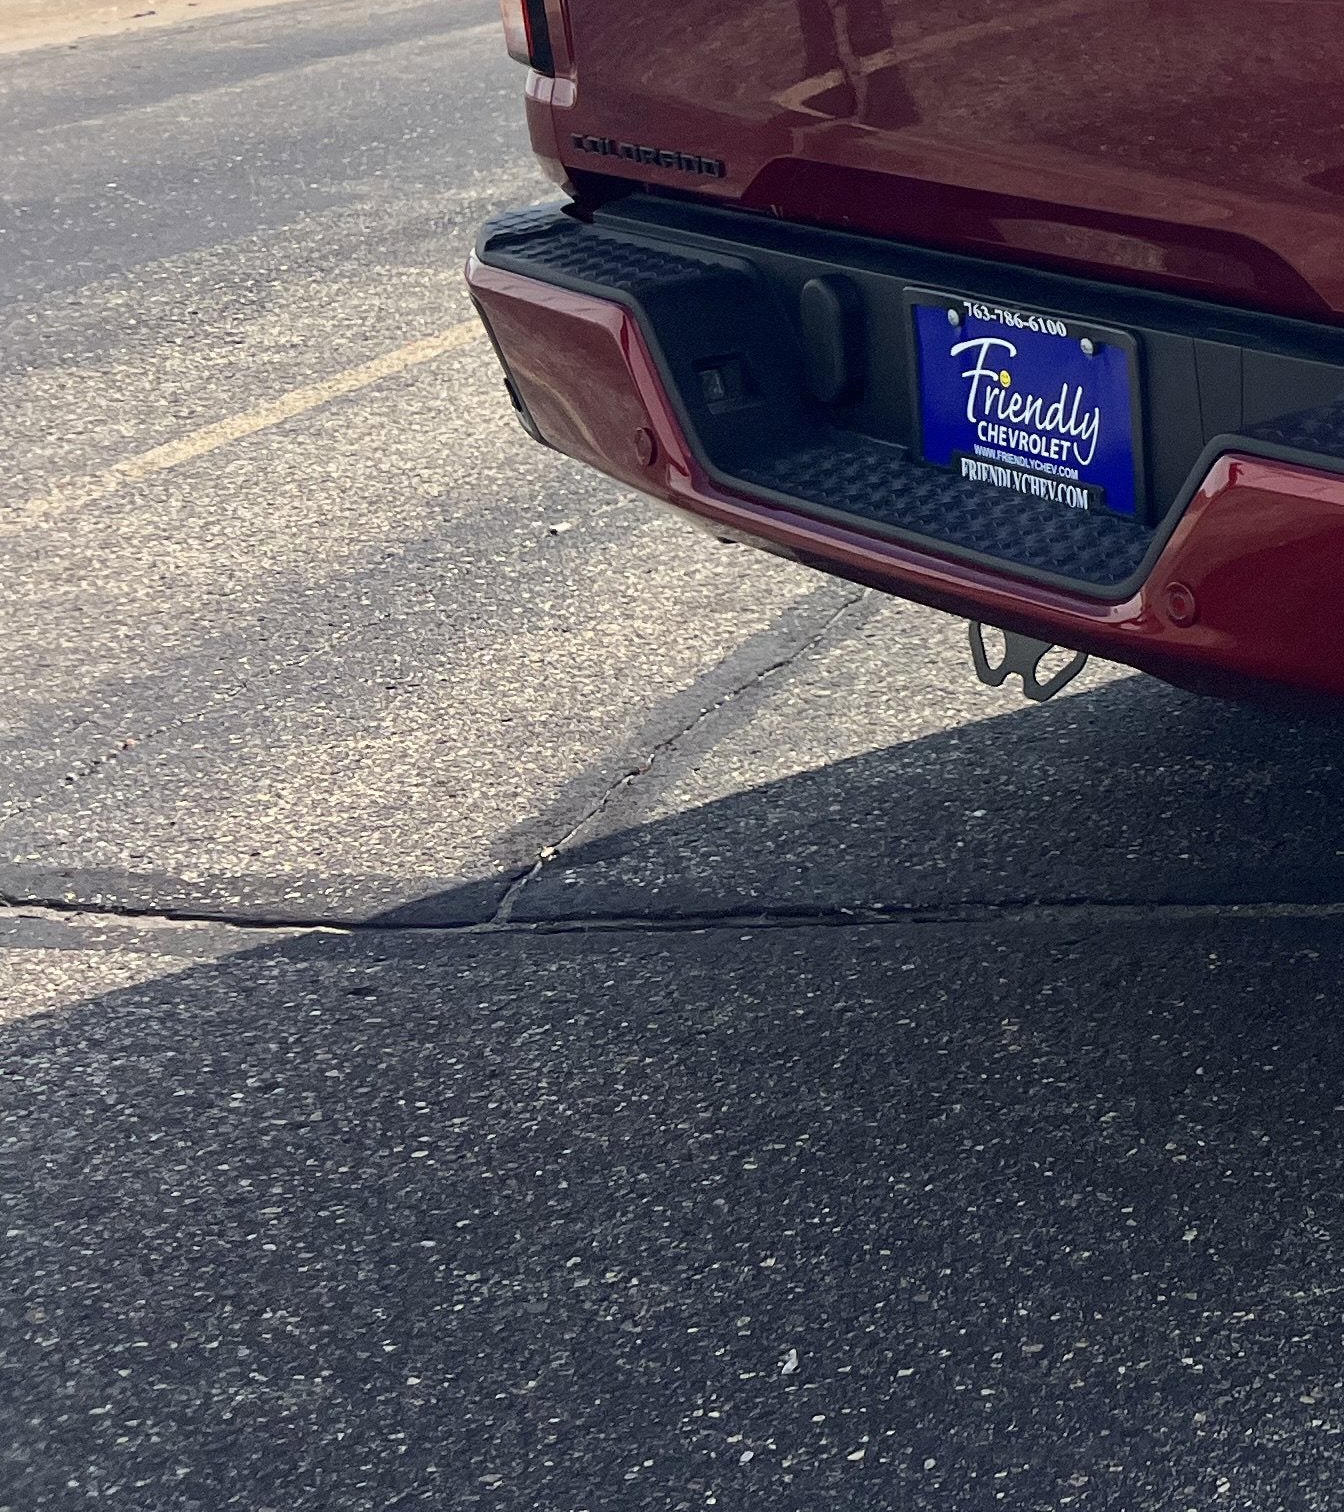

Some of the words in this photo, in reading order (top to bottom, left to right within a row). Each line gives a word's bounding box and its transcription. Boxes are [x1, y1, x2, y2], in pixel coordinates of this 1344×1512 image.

[570, 132, 726, 179] COLORADO
[963, 300, 1068, 338] 763-786-6100
[950, 336, 1100, 466] Friendly
[973, 443, 1080, 481] WWW.FRIENDLYCHEV.COM
[976, 420, 1072, 462] CHEVROLET
[960, 457, 1090, 511] FRIENDLYCHEV.COM
